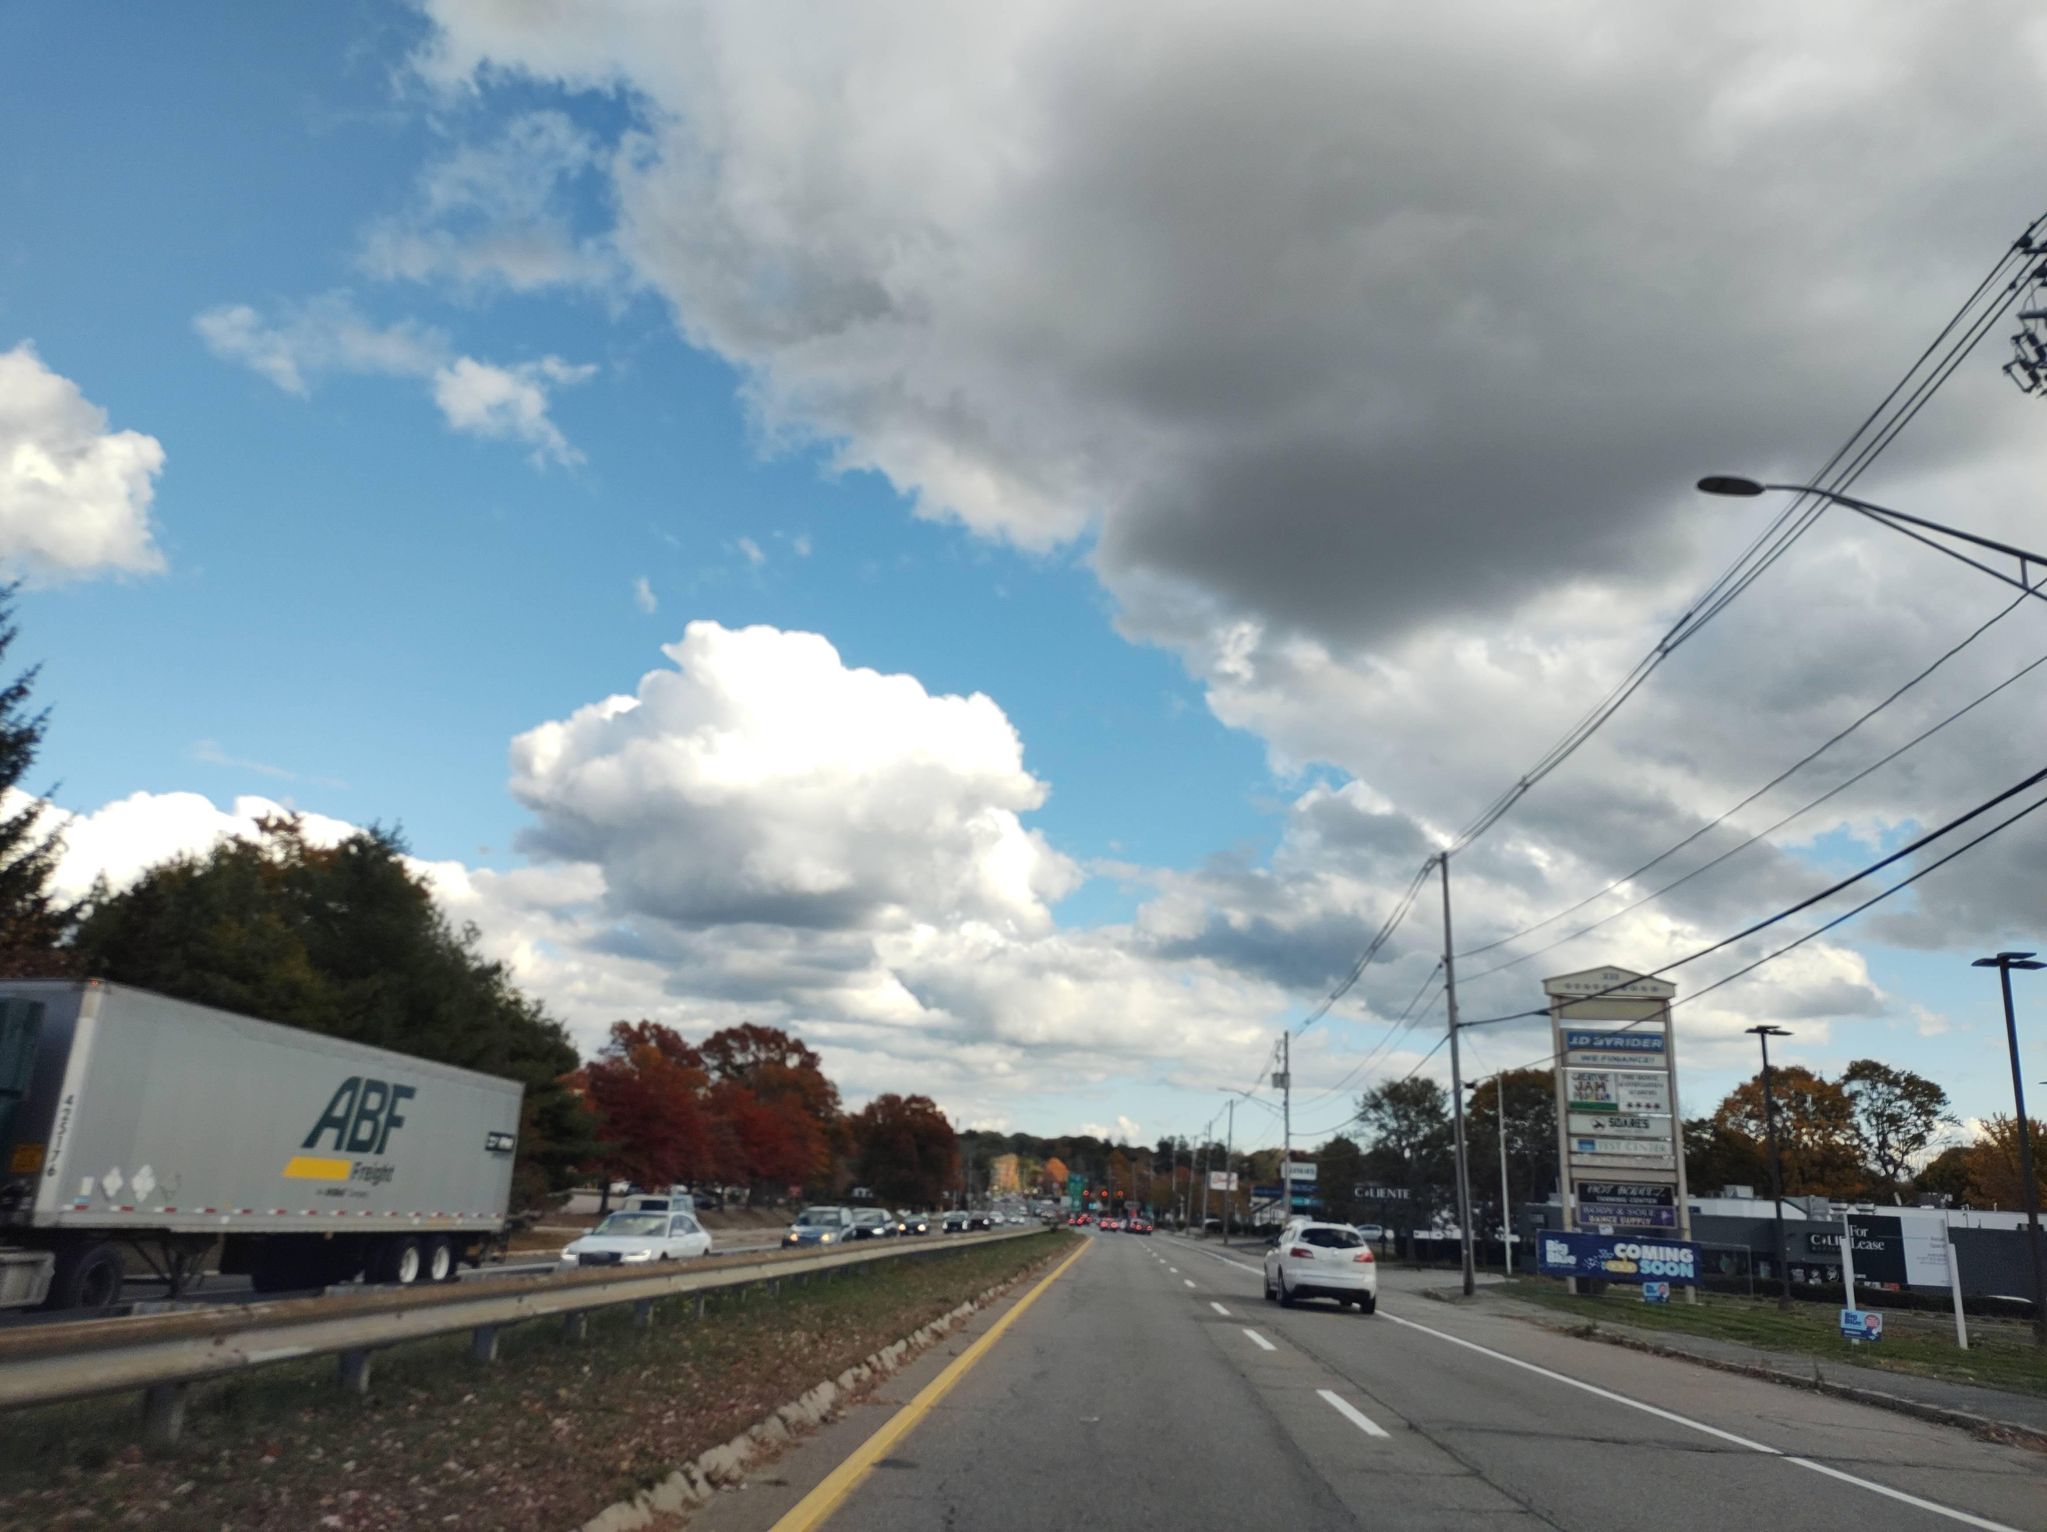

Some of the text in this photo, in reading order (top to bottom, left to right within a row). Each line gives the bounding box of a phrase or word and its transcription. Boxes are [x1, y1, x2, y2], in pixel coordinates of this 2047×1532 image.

[301, 1076, 417, 1155] ABF
[351, 1161, 395, 1187] Freight
[1849, 1224, 1869, 1238] For
[1614, 1243, 1694, 1263] COMING
[1849, 1237, 1885, 1251] Lease
[1640, 1260, 1694, 1278] SOON
